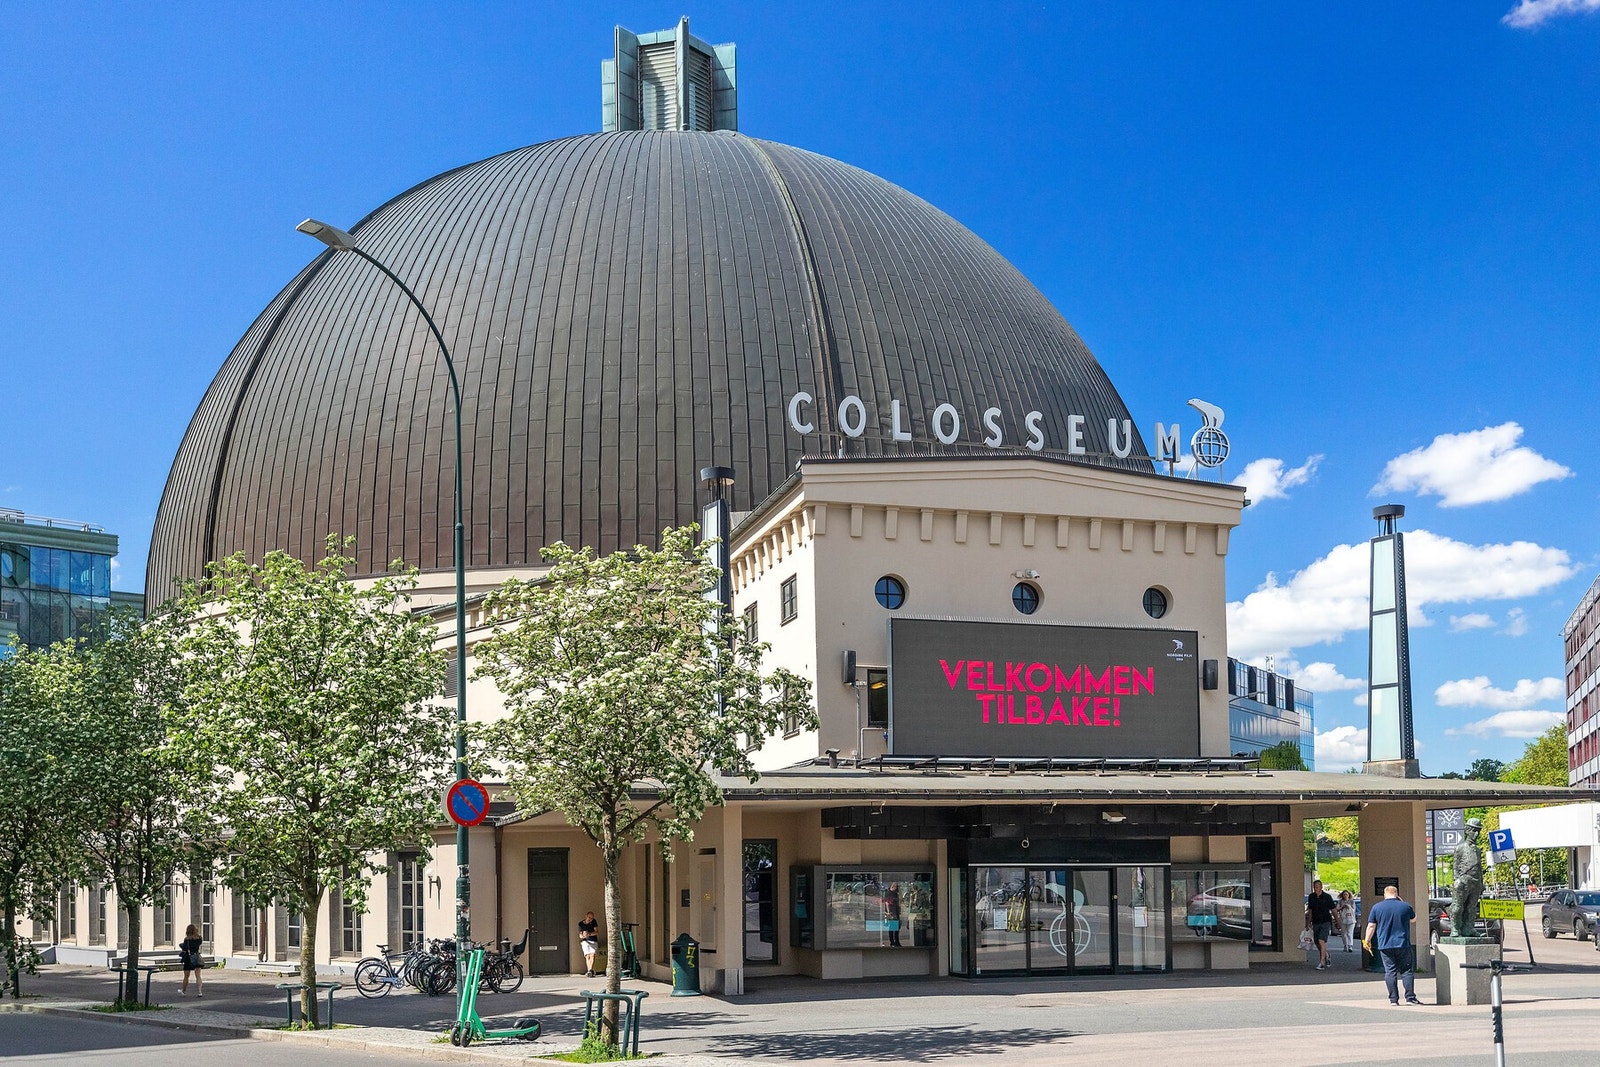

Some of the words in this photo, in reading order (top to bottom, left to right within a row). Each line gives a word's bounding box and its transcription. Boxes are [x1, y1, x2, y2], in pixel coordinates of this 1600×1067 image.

[788, 391, 1181, 463] COLOSSEUM
[939, 659, 1155, 696] VELKOMMEN
[976, 693, 1121, 727] TILBAKE!
[1446, 833, 1454, 843] P
[1494, 832, 1507, 850] P
